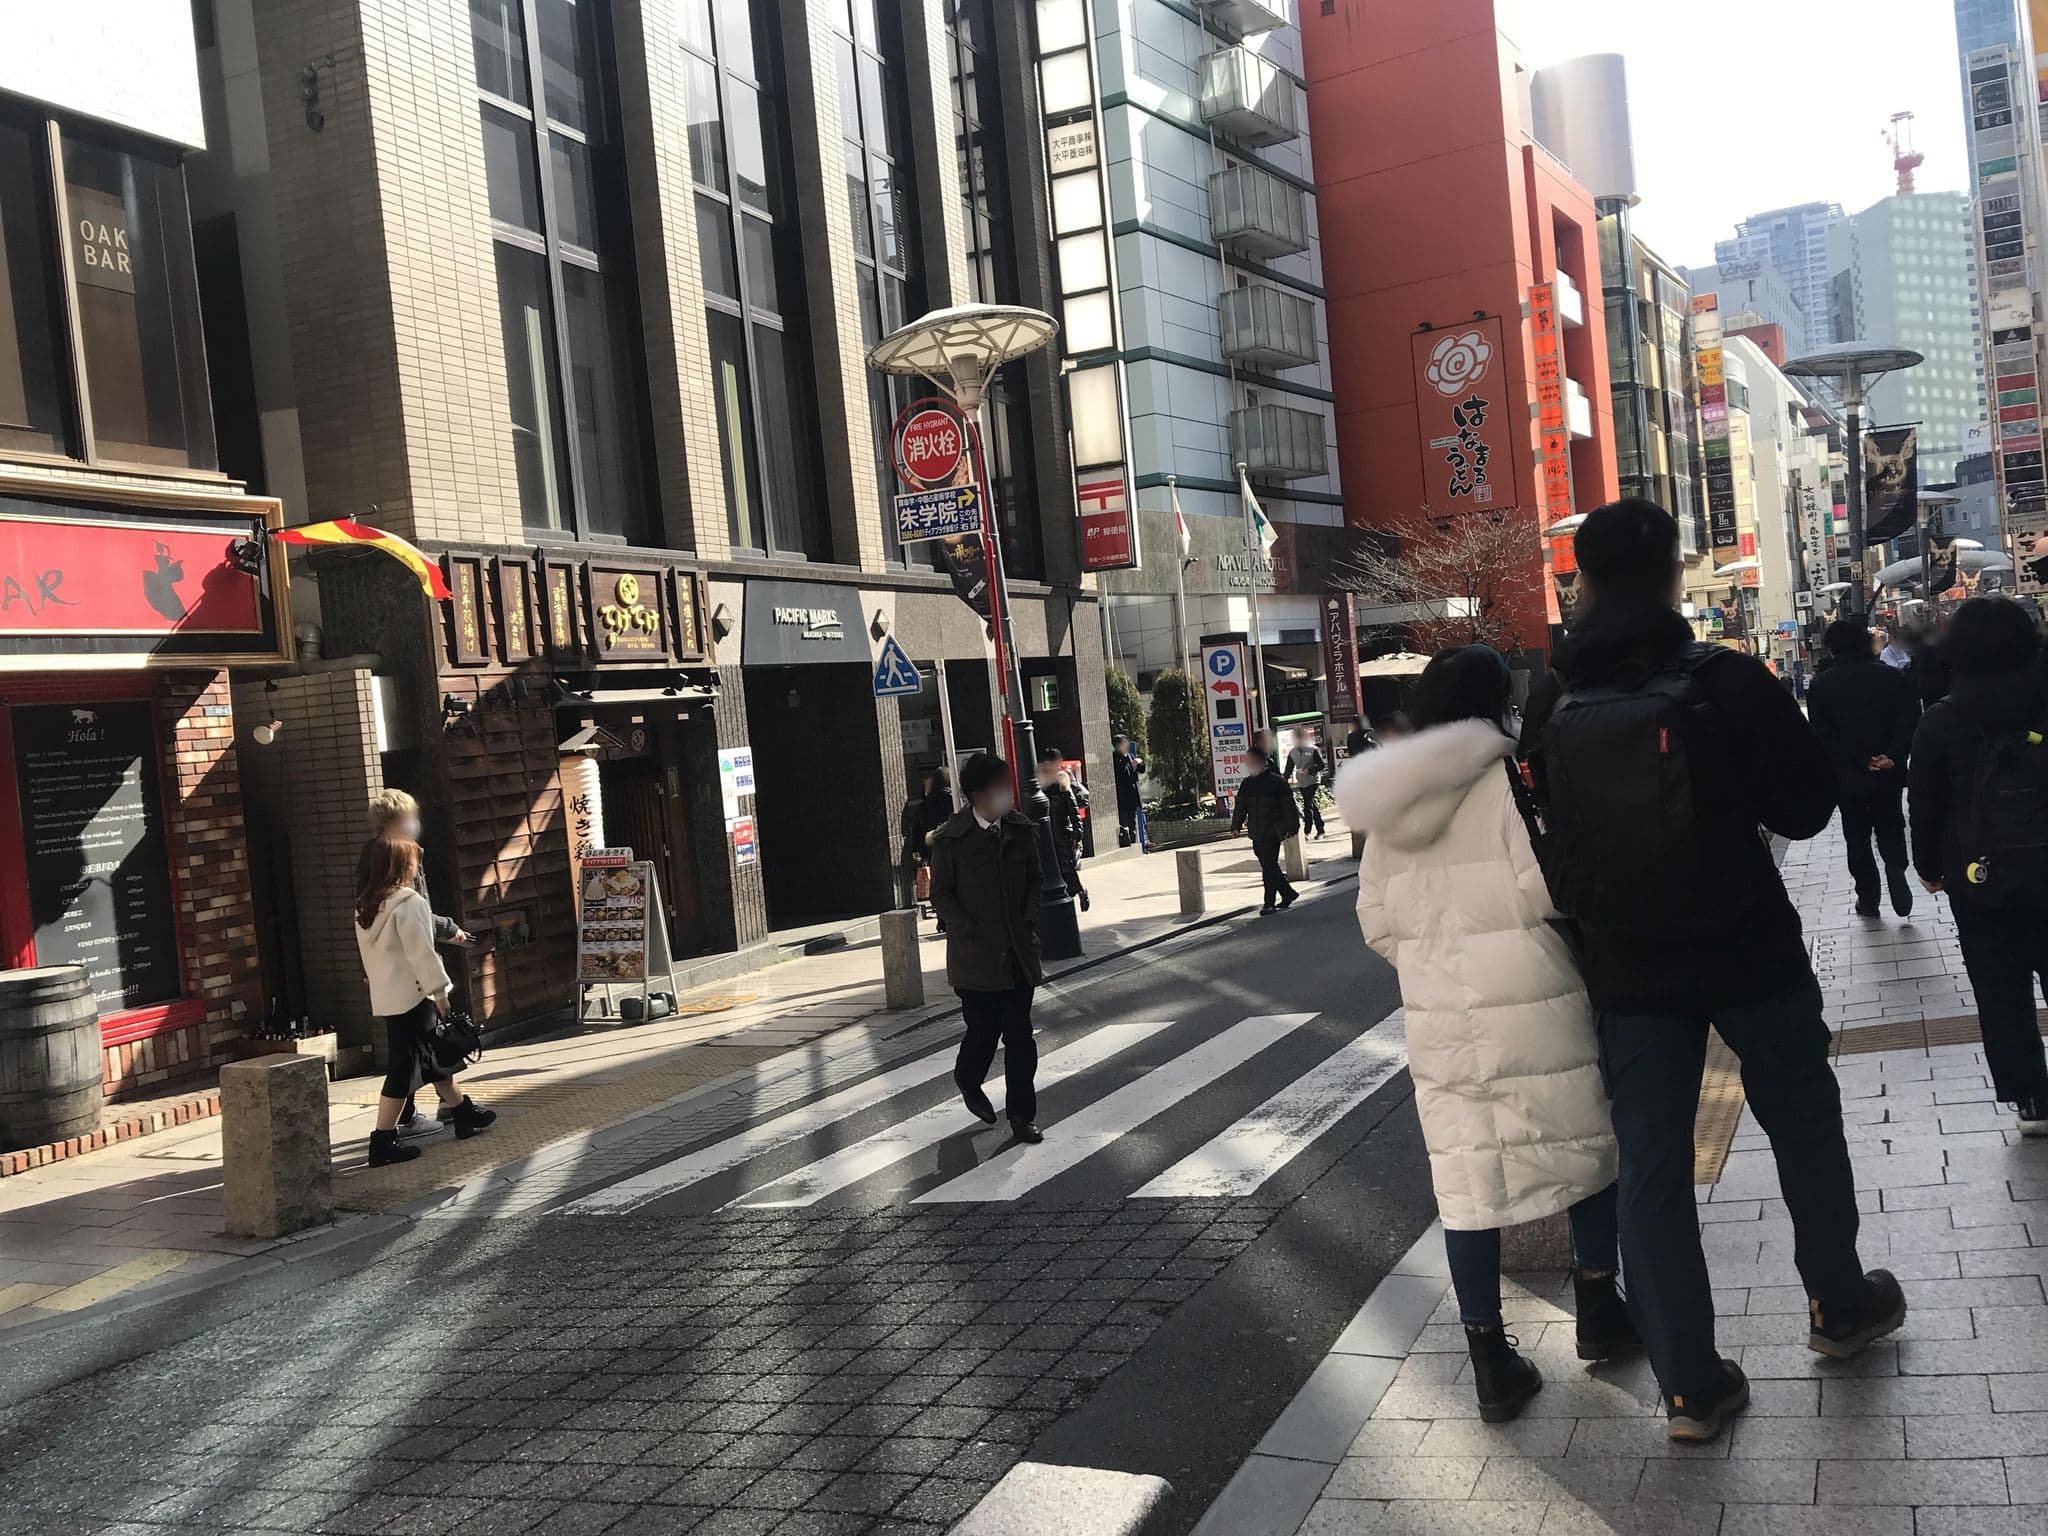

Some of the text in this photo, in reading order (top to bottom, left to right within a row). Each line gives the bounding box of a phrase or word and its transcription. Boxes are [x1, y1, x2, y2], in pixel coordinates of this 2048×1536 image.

[80, 220, 128, 250] OAK
[83, 244, 131, 274] BAR
[910, 418, 949, 432] FIRE HYDRANT
[908, 429, 957, 463] 消火栓
[1453, 393, 1489, 484] はなまる
[1446, 446, 1475, 497] うどん
[900, 500, 959, 530] 朱学院
[960, 522, 979, 531] 右折
[1103, 525, 1126, 536] 郵便局
[602, 604, 659, 632] てけてけ
[775, 607, 838, 624] PACIFIC MARKS
[1216, 655, 1230, 672] P
[67, 728, 97, 743] Hola
[1224, 766, 1241, 775] OK
